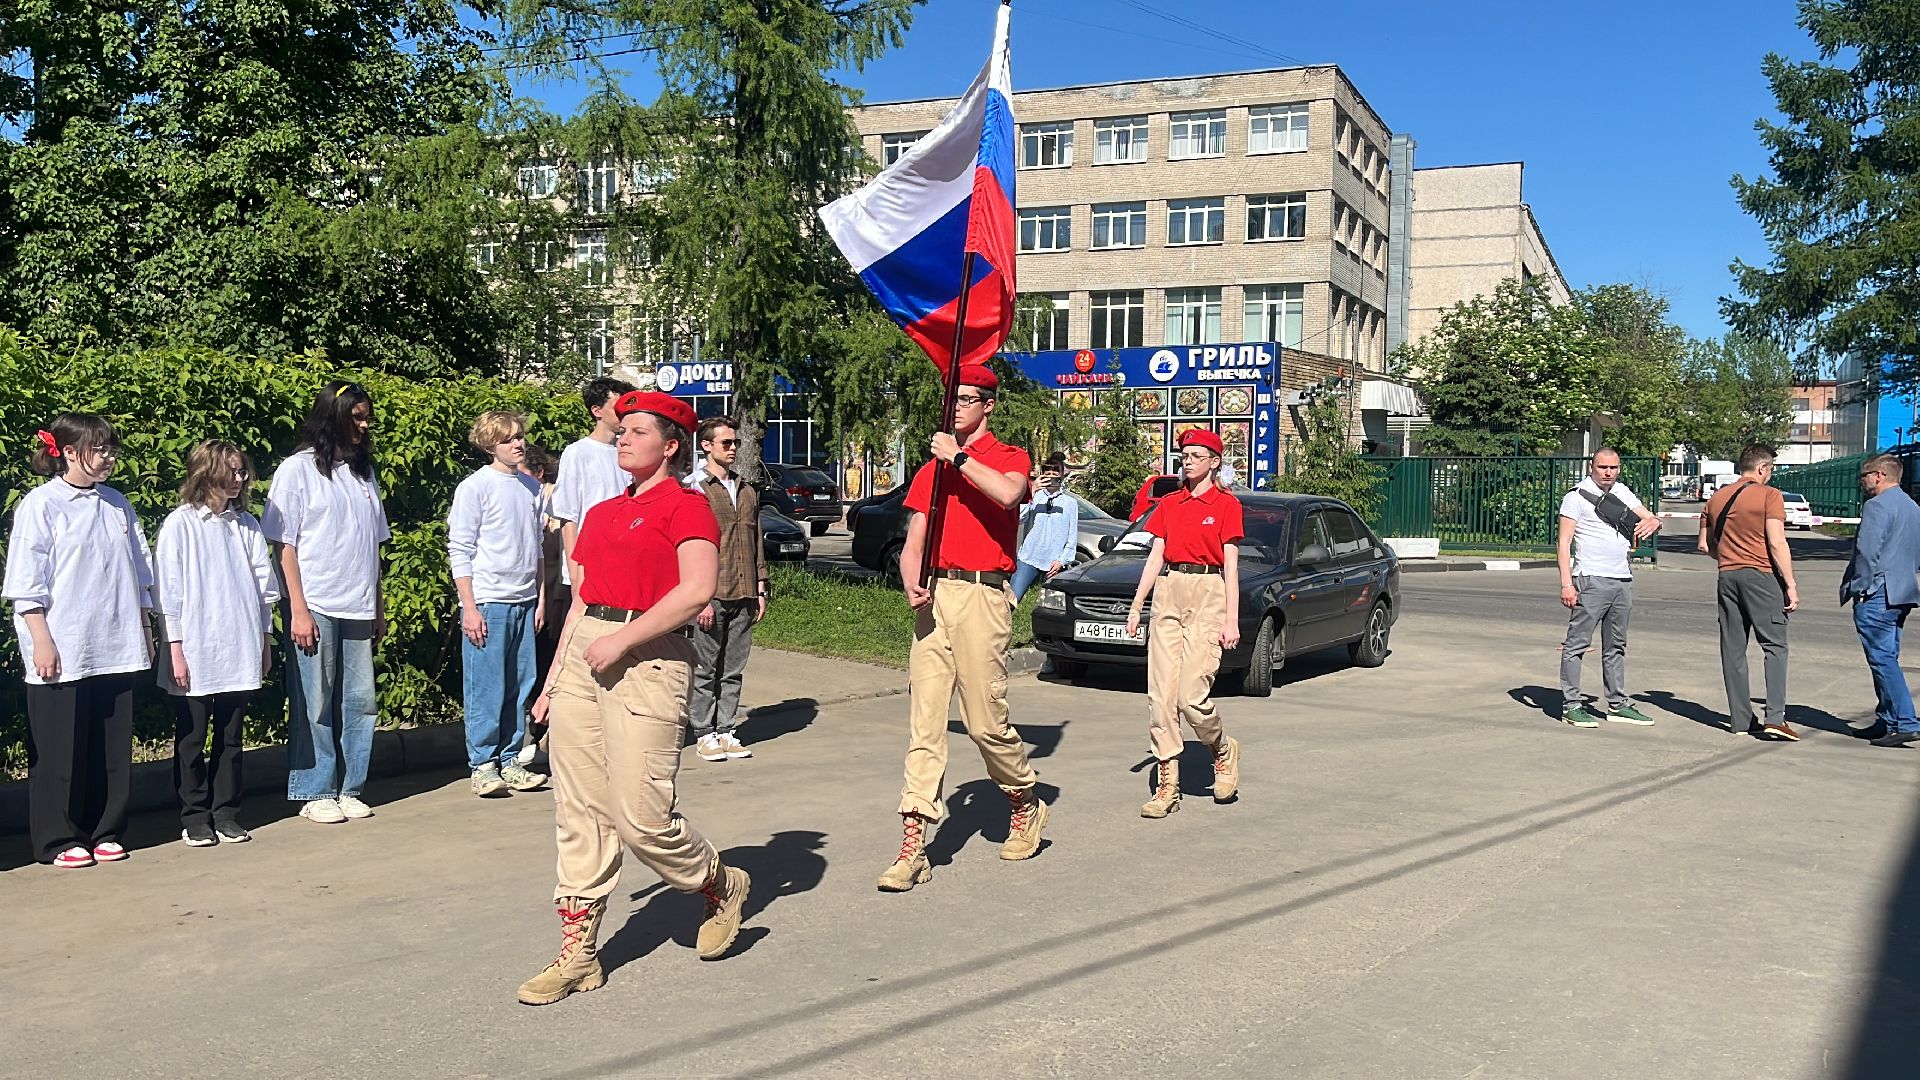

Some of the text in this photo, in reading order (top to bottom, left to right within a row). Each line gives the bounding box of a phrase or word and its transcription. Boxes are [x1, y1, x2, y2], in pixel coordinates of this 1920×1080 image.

[1079, 353, 1090, 363] 24
[1188, 346, 1272, 368] ГРИЛЬ
[1197, 368, 1262, 381] ВЫПЕЧКА
[706, 381, 732, 393] ЦЕН
[1256, 393, 1271, 488] ШАУРМА
[1079, 624, 1122, 638] А481ЕН
